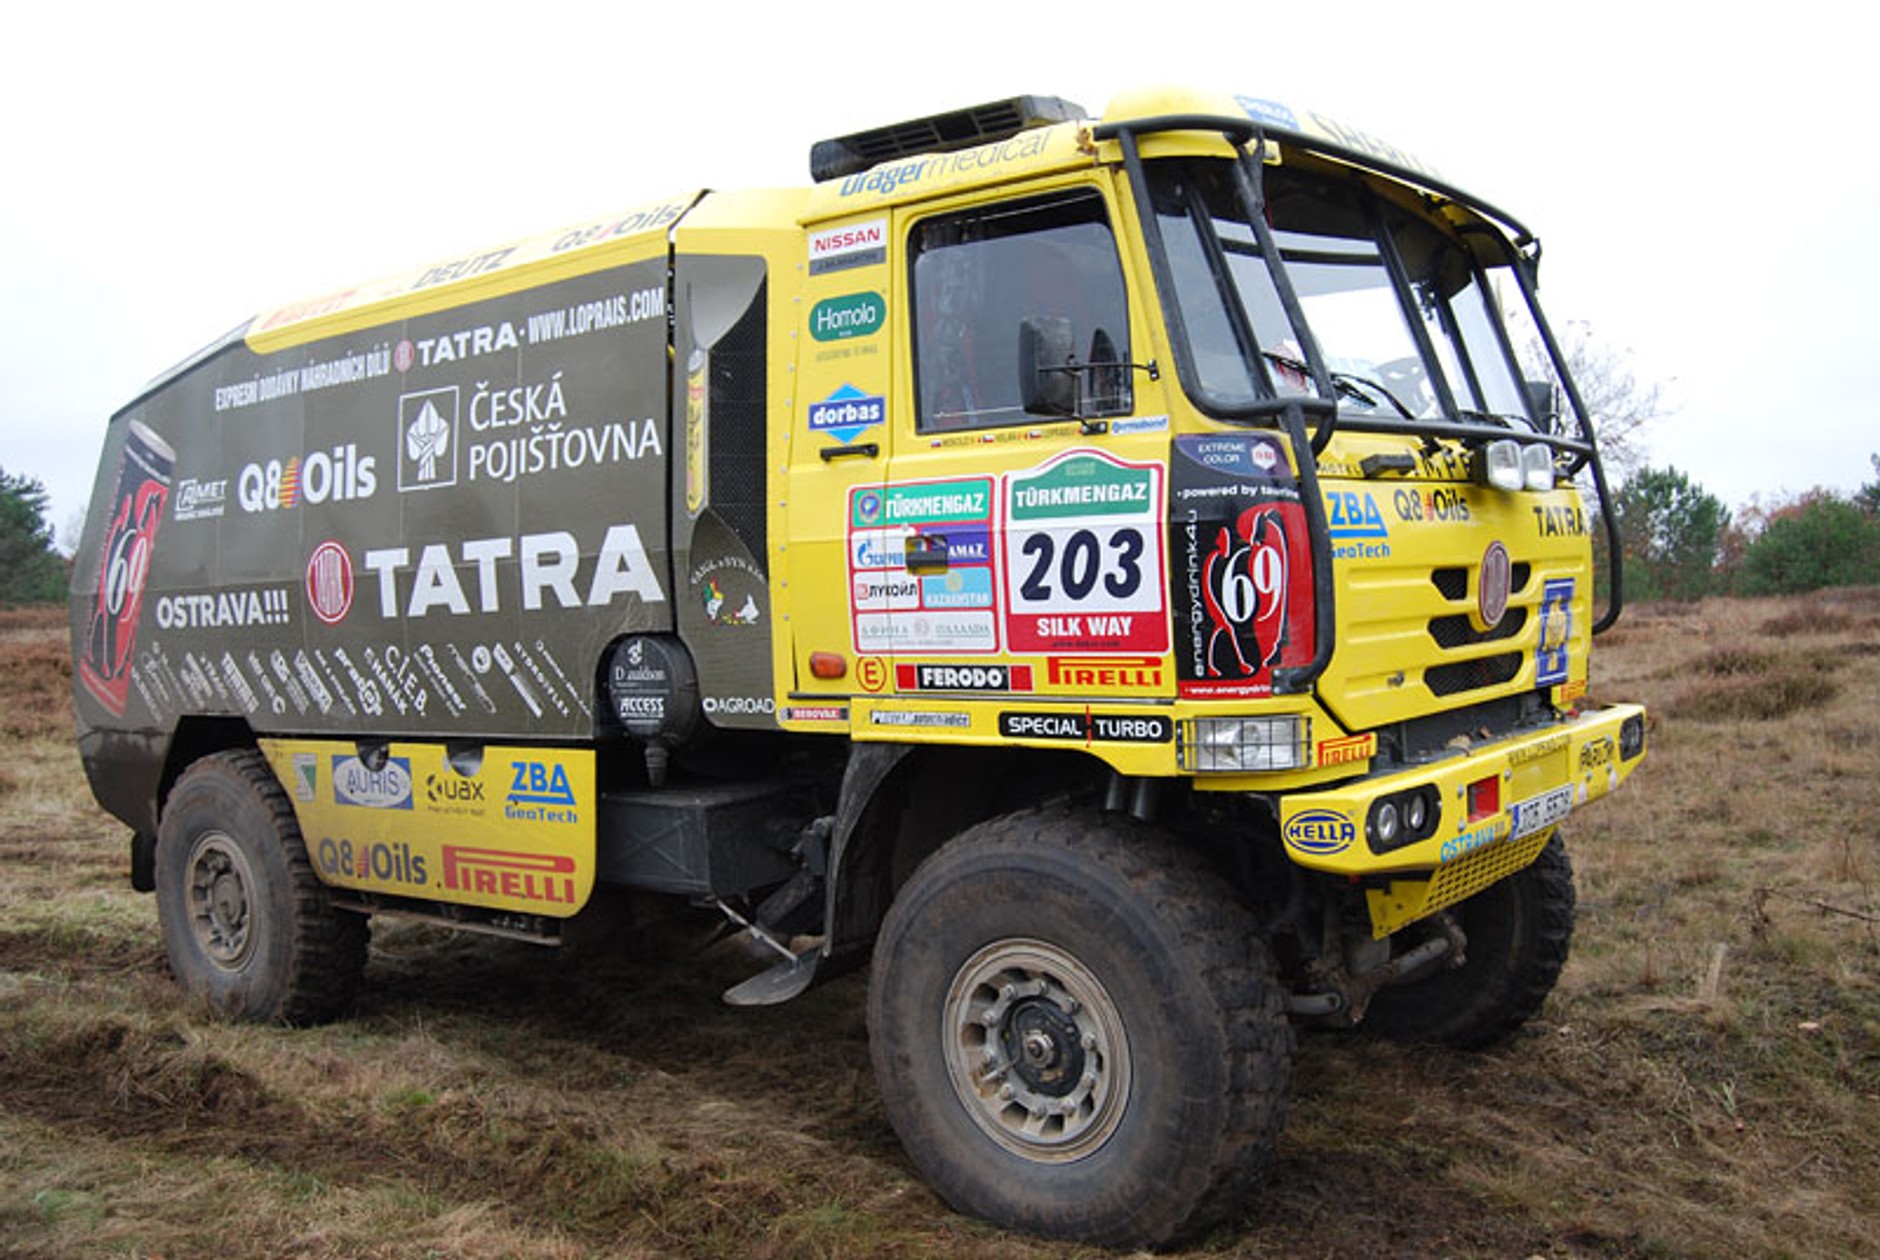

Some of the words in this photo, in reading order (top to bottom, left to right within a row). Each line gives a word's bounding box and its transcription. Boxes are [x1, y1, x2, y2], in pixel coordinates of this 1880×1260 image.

[815, 226, 881, 251] NISSAN
[528, 286, 665, 344] WWW.LOPRAIS.COM
[417, 321, 519, 366] TATRA
[468, 371, 568, 432] ČESKÁ
[814, 403, 881, 425] dorbas
[469, 418, 663, 482] POJIŠŤOVNA
[1199, 442, 1246, 453] EXTREME
[1204, 455, 1240, 464] COLOR
[239, 461, 283, 513] Q8
[303, 444, 377, 504] Oils
[1182, 484, 1238, 499] powered
[1241, 484, 1258, 497] by
[1015, 482, 1148, 508] TÜRKMENGAZ
[1393, 488, 1423, 521] Q8
[1433, 488, 1470, 521] Oils
[1532, 506, 1588, 537] TATRA
[365, 523, 666, 619] TATRA
[1020, 529, 1144, 601] 203
[1184, 509, 1205, 677] energydrink4u
[1222, 546, 1283, 622] 69
[157, 590, 290, 628] OSTRAVA!!!
[1037, 618, 1082, 636] SILK
[1087, 616, 1133, 635] WAY
[922, 668, 1003, 687] FERODO
[1048, 657, 1162, 686] PIRELLI
[620, 698, 664, 712] ACCESS
[1008, 717, 1082, 736] SPECIAL
[1097, 719, 1162, 738] TURBO
[1318, 734, 1372, 768] PIRELLI
[347, 767, 400, 796] AURIS
[1290, 822, 1355, 842] HELLA
[318, 837, 353, 876] Q8
[372, 842, 428, 886] Oils
[441, 845, 576, 904] PIRELLI
